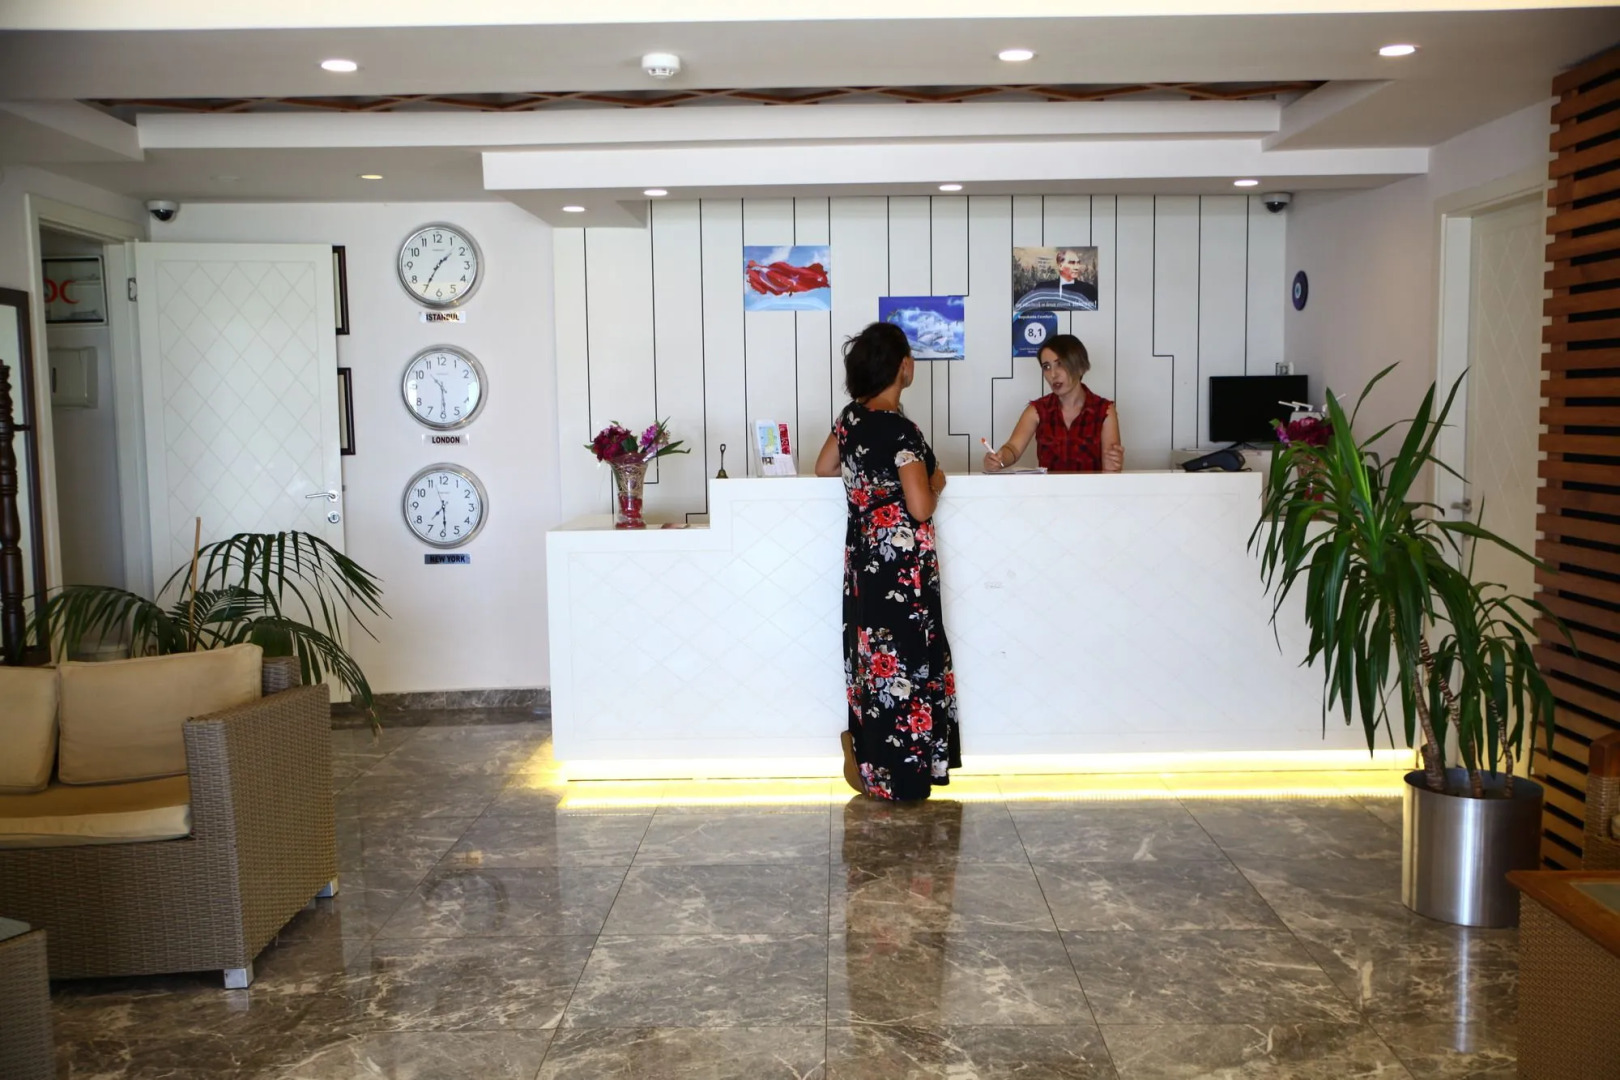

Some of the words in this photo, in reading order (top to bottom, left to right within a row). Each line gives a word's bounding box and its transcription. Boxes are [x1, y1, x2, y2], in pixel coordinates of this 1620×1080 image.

[422, 238, 427, 247] 11
[433, 234, 442, 243] 12
[411, 248, 420, 256] 10
[459, 246, 466, 256] 2
[407, 262, 413, 270] 9
[464, 261, 470, 270] 3
[412, 275, 418, 284] 8
[424, 284, 429, 293] 7
[436, 288, 442, 297] 6
[450, 285, 456, 294] 5
[1028, 328, 1042, 338] 8,1
[426, 361, 432, 370] 11
[437, 356, 446, 366] 12
[416, 370, 424, 380] 10
[463, 370, 469, 378] 2
[416, 397, 422, 406] 8
[428, 406, 434, 415] 7
[440, 410, 446, 419] 6
[454, 406, 460, 416] 5
[428, 480, 434, 488] 11
[440, 476, 448, 485] 12
[418, 488, 426, 498] 10
[464, 490, 470, 498] 2
[412, 502, 419, 510] 9
[468, 504, 474, 512] 3
[416, 515, 422, 524] 8
[464, 516, 470, 524] 4
[428, 524, 434, 533] 7
[440, 528, 446, 538] 6
[454, 526, 460, 534] 5
